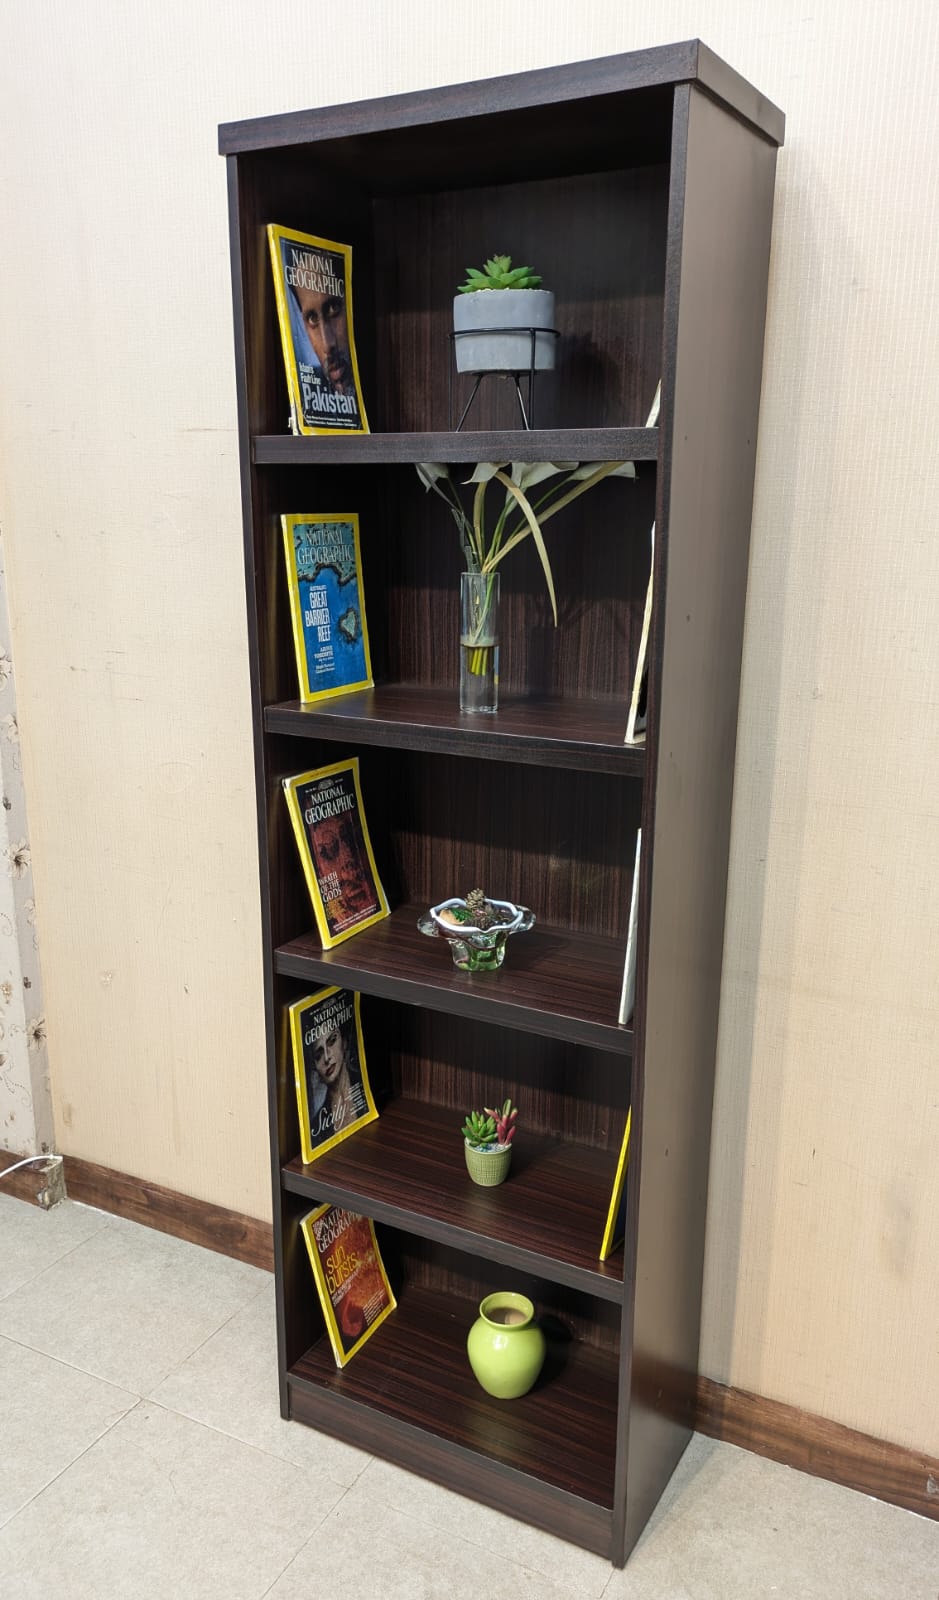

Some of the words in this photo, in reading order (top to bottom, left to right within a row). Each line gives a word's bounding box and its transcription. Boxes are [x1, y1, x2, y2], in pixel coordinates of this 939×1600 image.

[291, 248, 336, 277] NATIONAL
[284, 265, 345, 298] GEOGRAPHIC
[302, 383, 358, 415] Pakistan
[305, 529, 344, 547] NATIONAL
[297, 544, 354, 565] GEOGRAPHIC
[309, 591, 328, 609] GREAT
[304, 608, 330, 627] BARRIER
[317, 625, 331, 643] REEF
[310, 784, 345, 806] NATIONAL
[304, 793, 355, 825] GEOGRAPHIC
[319, 870, 338, 886] WRATH
[320, 882, 329, 894] OF
[328, 879, 340, 889] THE
[322, 886, 342, 903] GODS
[304, 1003, 353, 1046] GEOGRAPHIC
[313, 999, 346, 1027] NATIONAL
[311, 1095, 347, 1137] Sicily
[326, 1246, 346, 1274] sun
[326, 1252, 359, 1294] bursts
